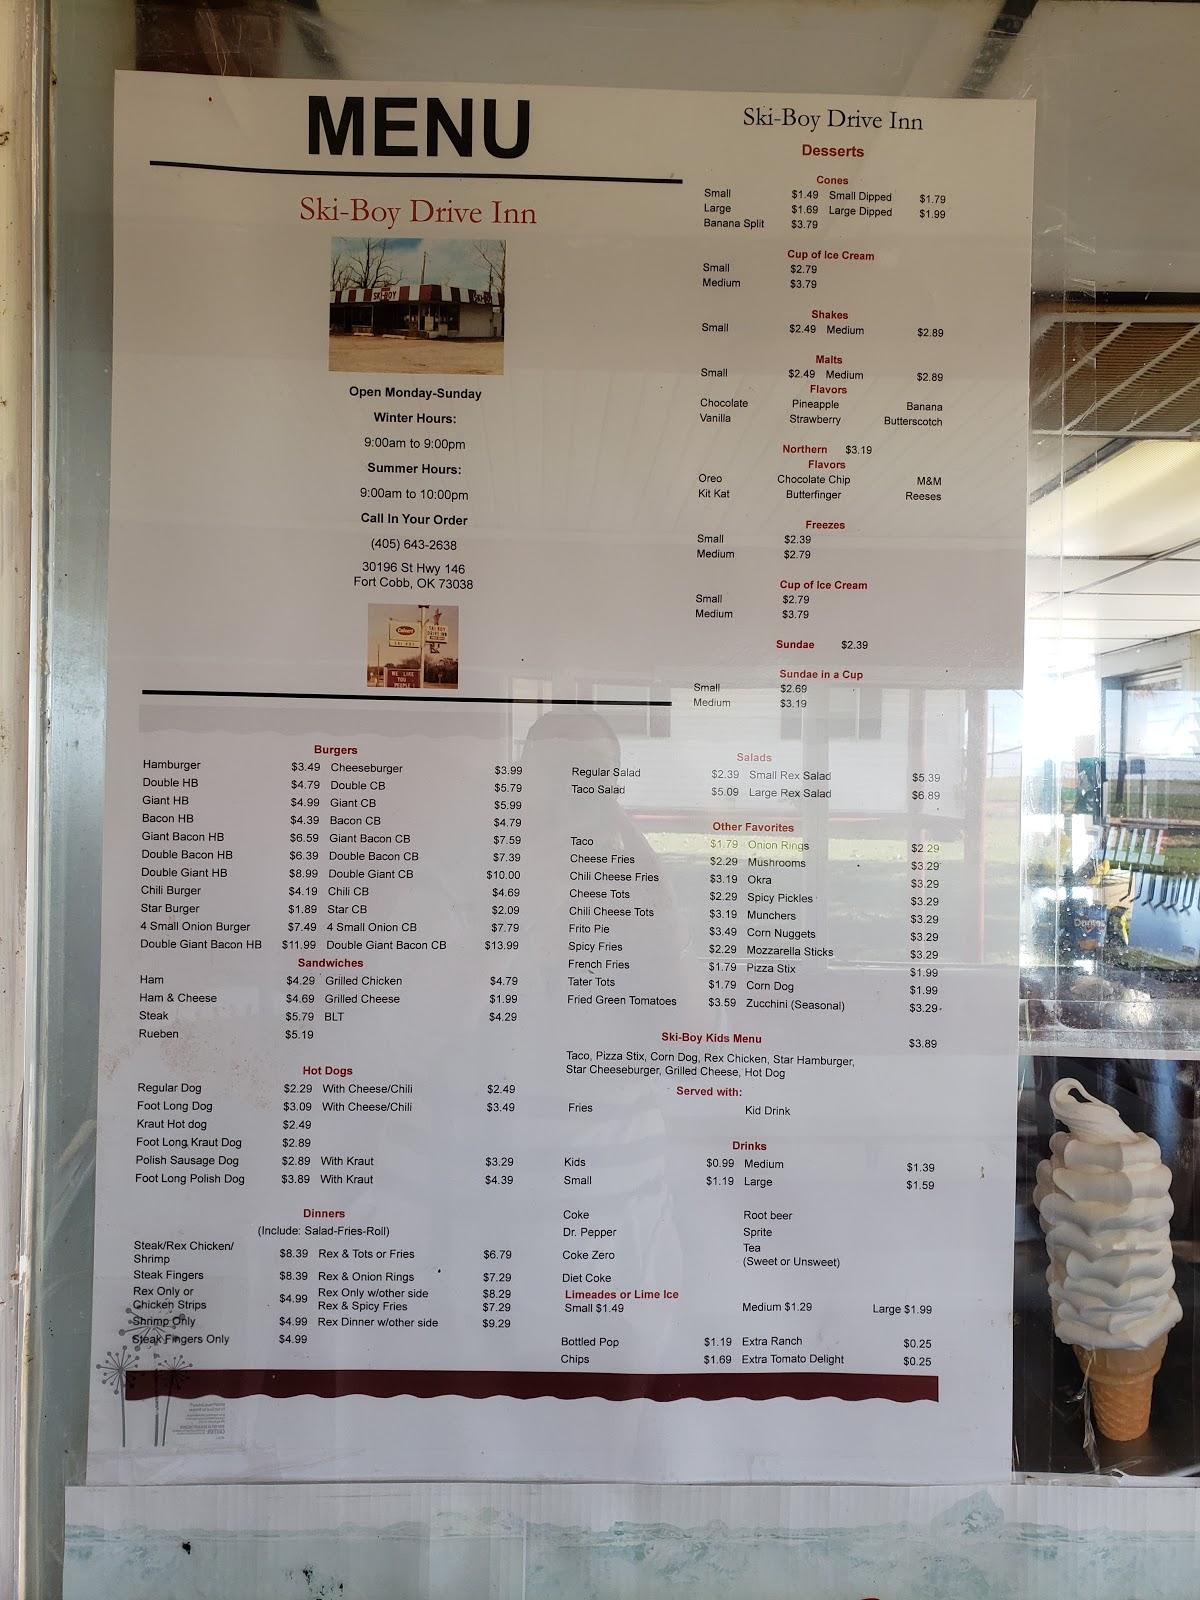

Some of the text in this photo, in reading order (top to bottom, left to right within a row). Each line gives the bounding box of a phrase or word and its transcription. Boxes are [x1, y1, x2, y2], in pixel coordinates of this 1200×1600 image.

[743, 106, 923, 133] Ski-Boy Drive Inn
[308, 95, 530, 159] MENU
[802, 144, 864, 157] Desserts
[816, 175, 849, 185] Cones
[704, 188, 819, 199] Small $1.49
[829, 190, 946, 204] Small Dipped $1.79
[300, 196, 537, 230] Ski-Boy Drive Inn
[704, 218, 818, 230] Banana Split $3.79
[787, 249, 875, 261] Cup of Ice Cream
[702, 278, 817, 289] Medium $3.79
[811, 309, 849, 320] Shakes
[702, 322, 816, 334] Small $2.49
[827, 325, 944, 338] Medium $2.89
[816, 355, 843, 364] Malts
[349, 386, 482, 402] Open Monday-Sunday
[700, 398, 748, 408] Chocolate
[792, 399, 839, 411] Pineapple
[907, 402, 943, 412] Banana
[374, 412, 456, 424] Winter Hours:
[699, 413, 731, 423] Vanilla
[789, 414, 841, 426] Strawberry
[884, 416, 942, 426] Butterscotch
[364, 437, 465, 452] 9:00am to 9:00pm
[783, 444, 872, 455] Northern $3.19
[368, 462, 461, 475] Summer Hours:
[698, 473, 723, 483] Oreo
[777, 474, 851, 486] Chocolate Chip
[917, 476, 941, 486] M&M
[360, 487, 468, 503] 9:00am to 10:00pm
[698, 489, 730, 498] Kit Kat
[786, 489, 842, 501] Butterfinger
[905, 491, 942, 501] Reeses
[361, 512, 468, 526] Call In Your Order
[806, 520, 845, 529] Freezes
[371, 538, 457, 551] (405) 643-2638
[362, 561, 465, 576] 30196 St Hwy 146
[354, 576, 473, 590] Fort Cobb, OK 73038
[780, 669, 818, 679] Sundae
[821, 670, 830, 679] in
[842, 670, 863, 681] Cup
[694, 683, 807, 693] Small $2.69
[314, 745, 358, 757] Burgers
[737, 753, 772, 762] Salads
[143, 759, 321, 772] Hamburger $3.49
[331, 762, 523, 775] Cheeseburger $3.99
[572, 767, 739, 779] Regular Salad $2.39
[713, 822, 794, 832] Other Favorites
[141, 867, 318, 878] Double Giant HB $8.99
[329, 869, 521, 880] Double Giant CB $10.00
[298, 958, 364, 968] Sandwiches
[140, 993, 315, 1004] Ham & Cheese $4.69
[325, 994, 518, 1004] Grilled Cheese $1.99
[746, 998, 939, 1013] Zucchini (Seasonal) $3.29
[661, 1032, 937, 1049] Ski-Boy Kids Menu $3.89
[303, 1066, 353, 1078] Hot Dogs
[676, 1086, 742, 1097] Served with:
[733, 1141, 767, 1151] Drinks
[136, 1155, 311, 1168] Polish Sausage Dog $2.89
[320, 1156, 514, 1167] With Kraut $3.29
[303, 1209, 345, 1218] Dinners
[258, 1225, 390, 1238] (Include: Salad-Fries-Roll)
[743, 1256, 778, 1268] (Sweet
[793, 1257, 840, 1269] Unsweet)
[133, 1269, 308, 1282] Steak Fingers $8.39
[565, 1290, 617, 1299] Limeades
[634, 1290, 660, 1299] Lime
[663, 1290, 679, 1299] Ice
[561, 1337, 732, 1348] Bottled Pop $1.19
[742, 1336, 932, 1349] Extra Ranch $0.25
